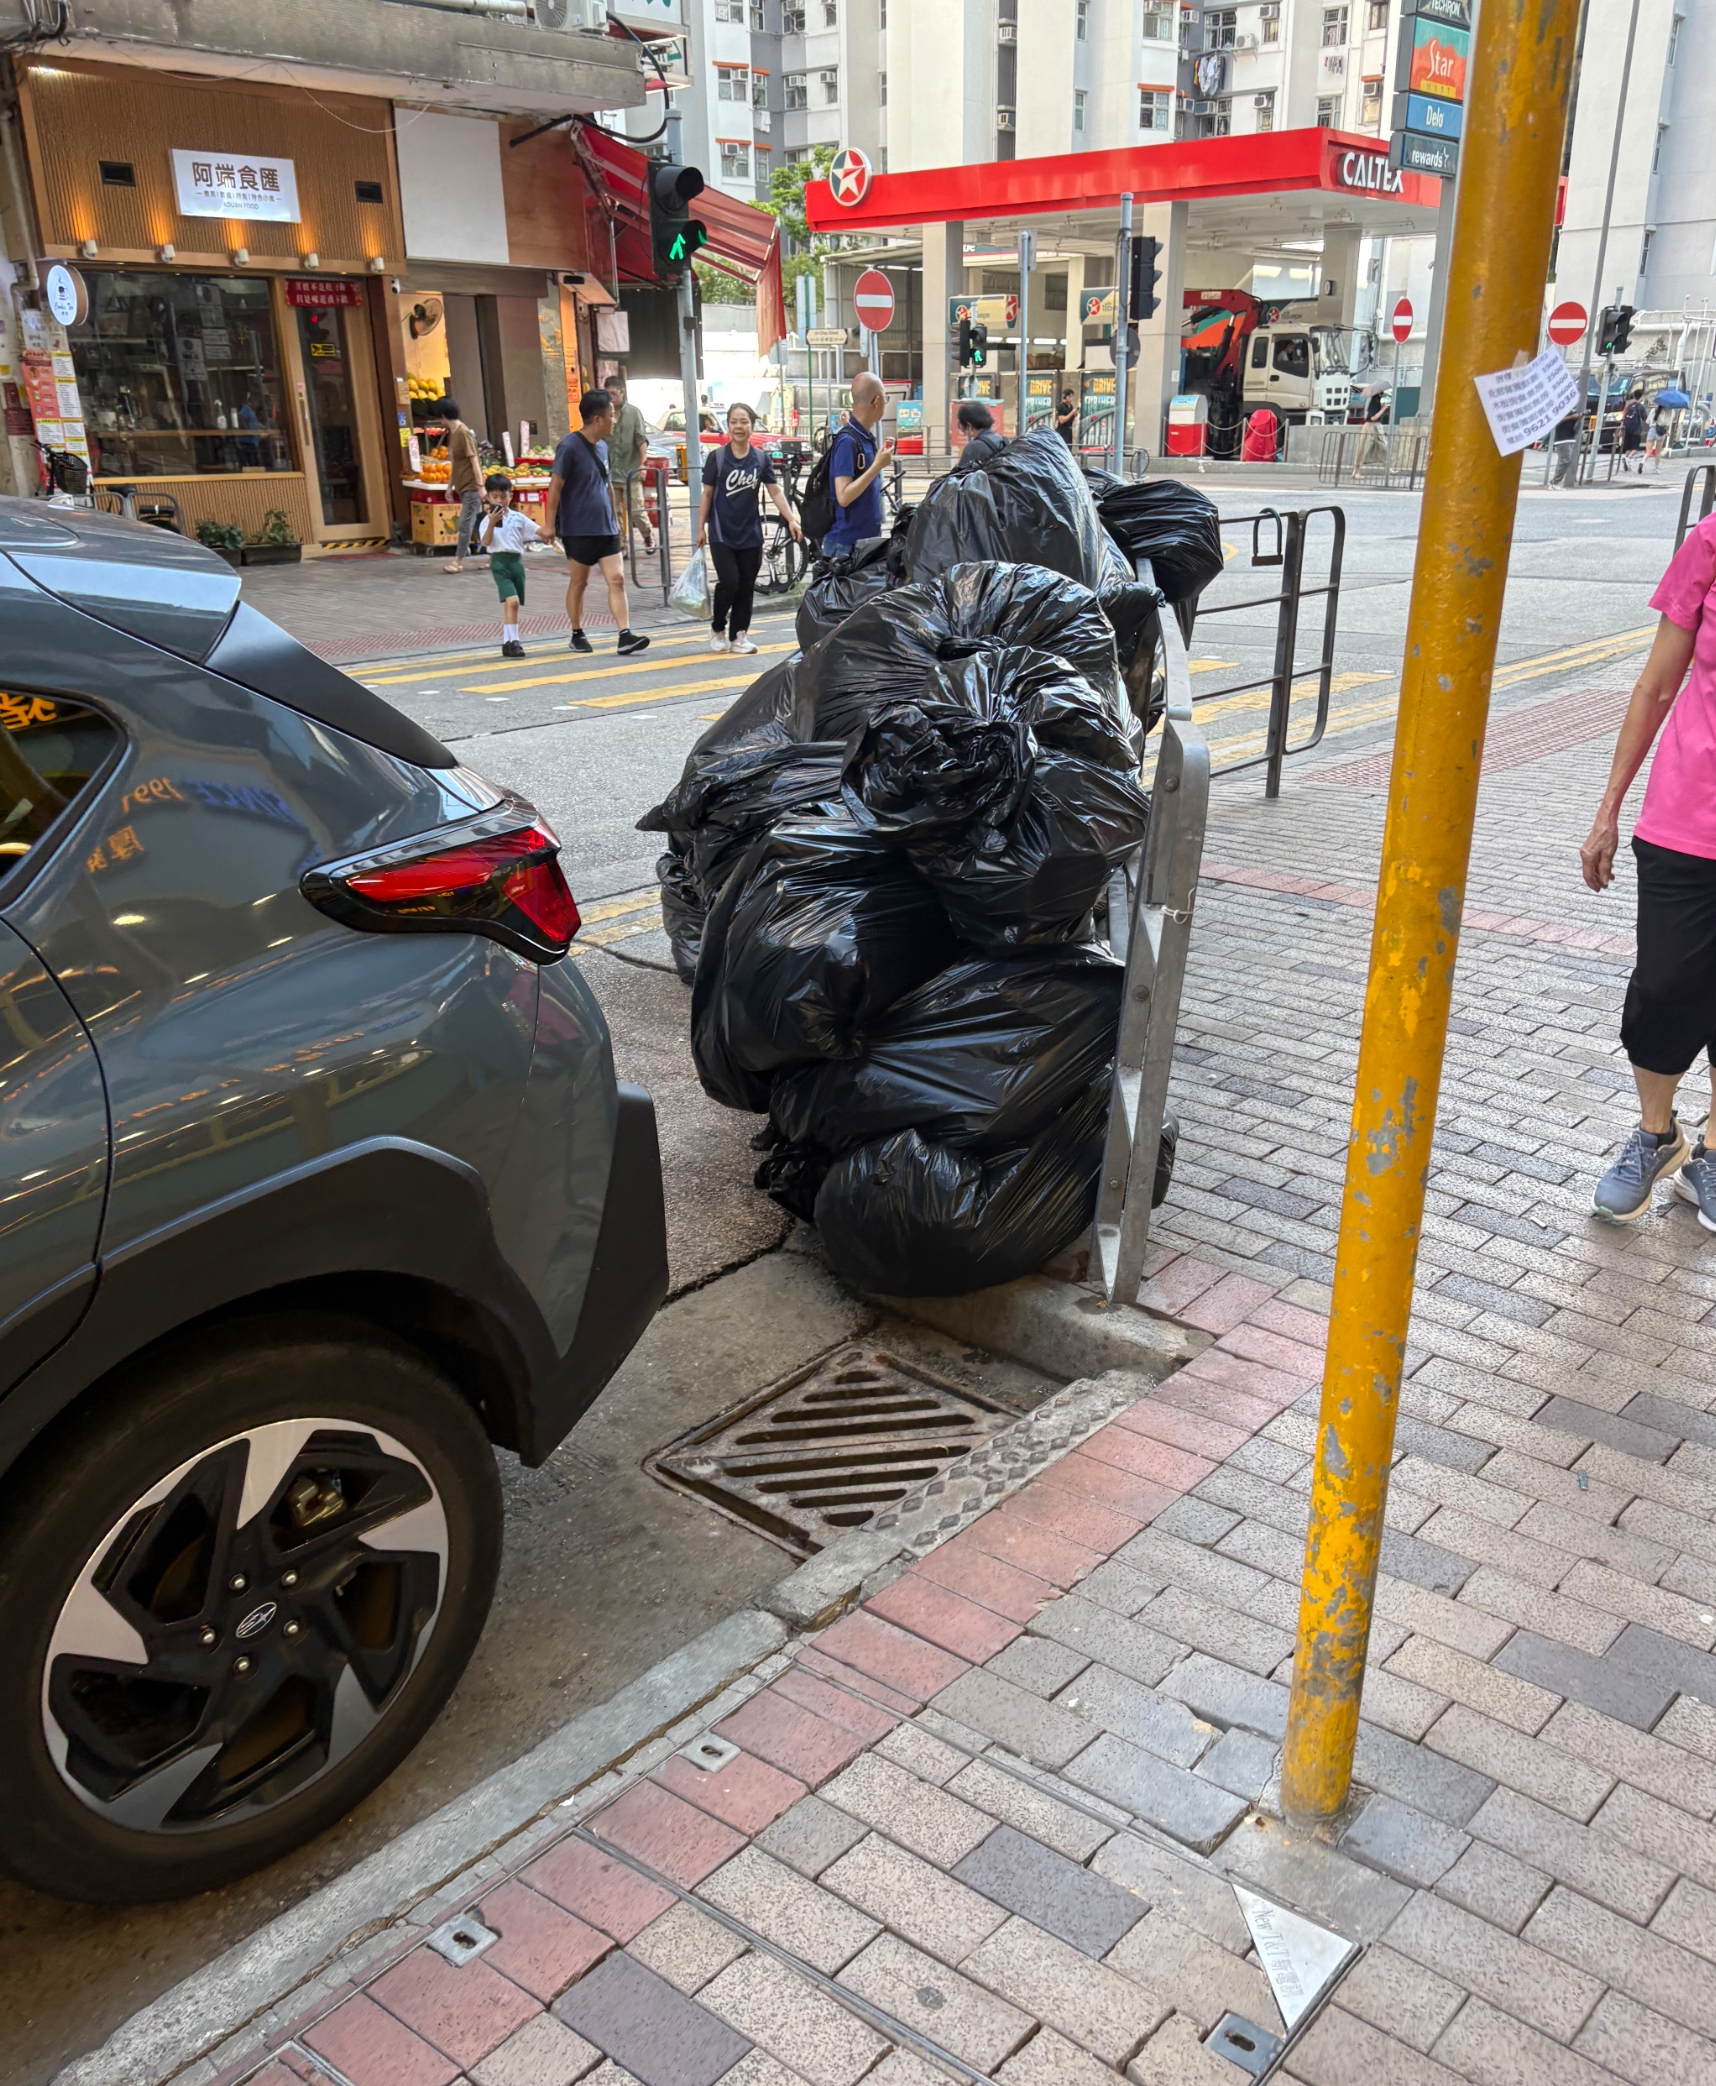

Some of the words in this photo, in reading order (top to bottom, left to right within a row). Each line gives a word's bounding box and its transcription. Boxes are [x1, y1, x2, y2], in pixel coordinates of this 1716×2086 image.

[1426, 39, 1454, 79] Star
[1425, 105, 1444, 128] Delo
[1411, 149, 1444, 168] rewards
[191, 162, 281, 192] 阿端食匯
[1343, 152, 1404, 193] CALTEX
[243, 202, 259, 210] FOOD
[1546, 364, 1564, 383] 2500
[1030, 379, 1052, 395] DRIVE
[1523, 415, 1553, 436] 9621
[1552, 389, 1577, 415] 9036
[725, 468, 758, 490] Chef
[1252, 1909, 1275, 1932] New
[1262, 1933, 1290, 1956] T&T
